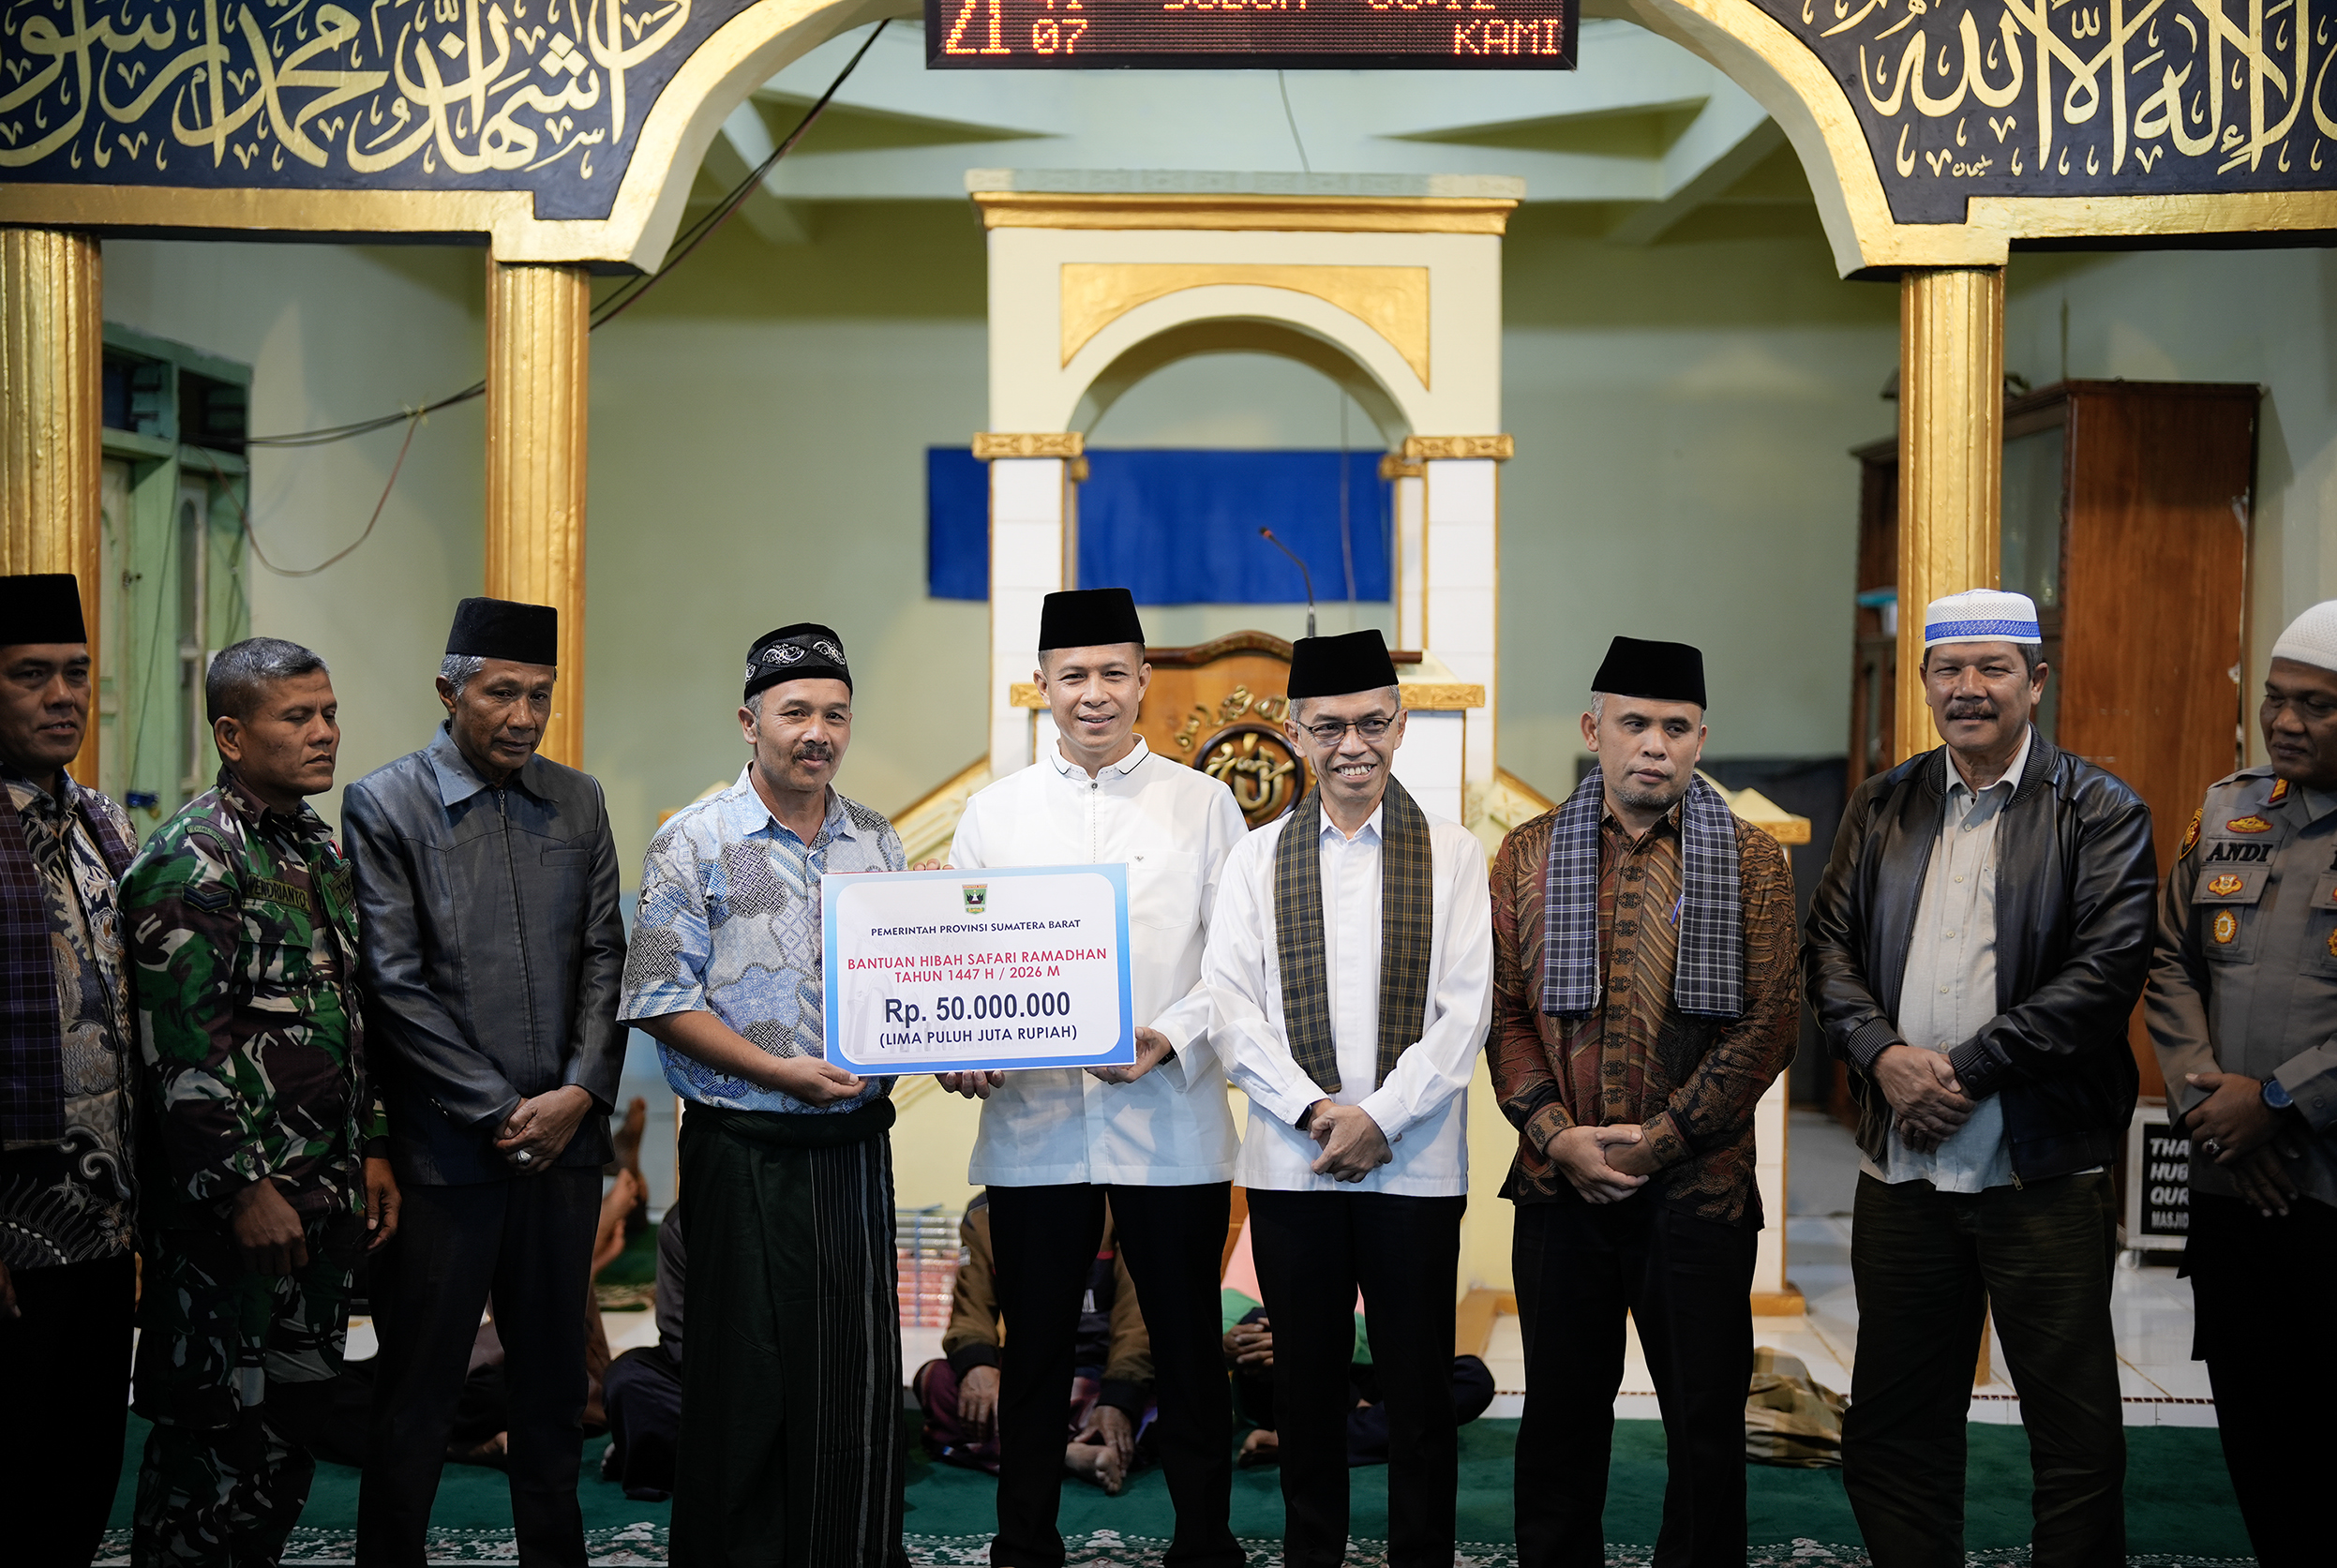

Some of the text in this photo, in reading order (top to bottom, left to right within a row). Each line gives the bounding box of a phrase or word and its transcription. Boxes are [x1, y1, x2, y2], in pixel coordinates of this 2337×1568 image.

[1032, 18, 1088, 54] 07
[1453, 18, 1559, 54] KAMI
[2206, 843, 2274, 862] ANDI
[871, 918, 1081, 936] PEMERINTAH PROVINSI SUMATERA BARAT
[847, 948, 1107, 970] BANTUAN HIBAH SAFARI RAMADHAN
[894, 964, 1060, 983] TAHUN 1447 H / 2026 M
[885, 991, 1071, 1029] Rp. 50.000.000
[879, 1024, 1077, 1049] (LIMA PULUH JUTA RUPIAH)
